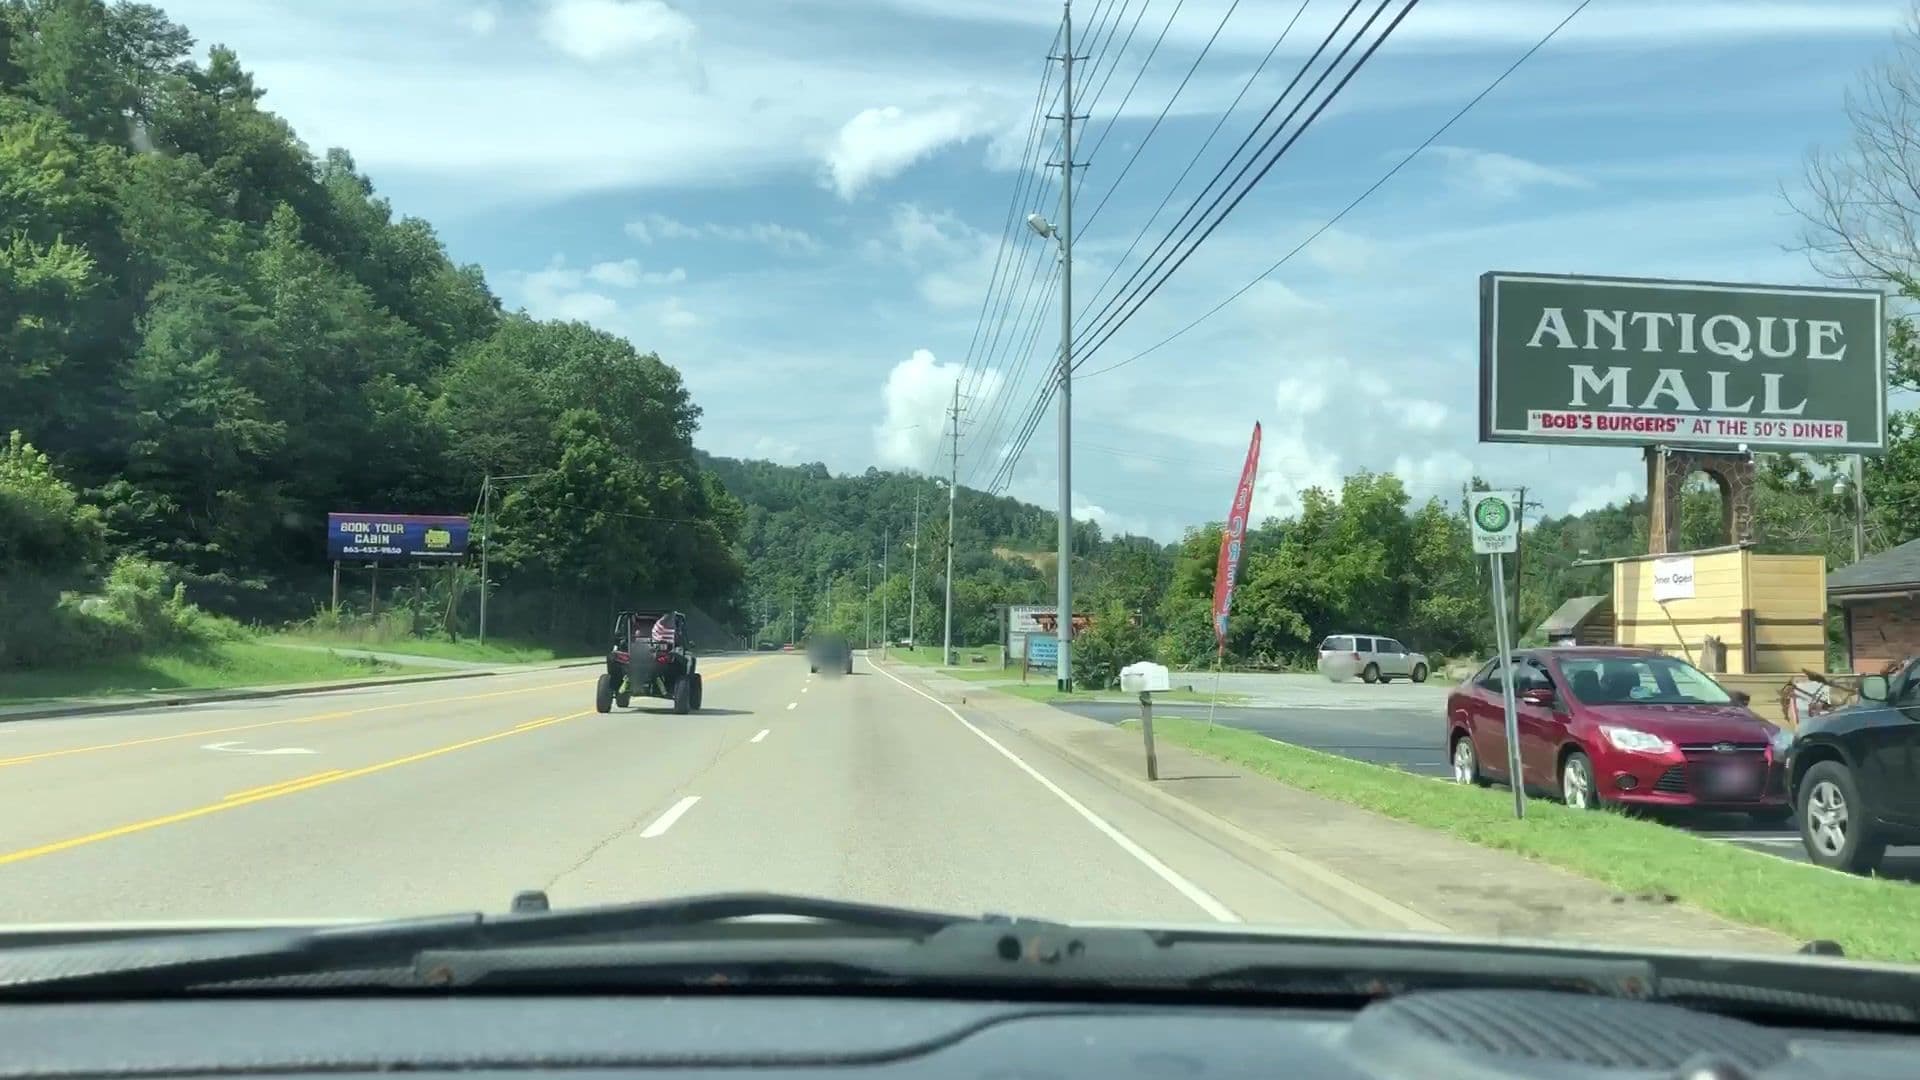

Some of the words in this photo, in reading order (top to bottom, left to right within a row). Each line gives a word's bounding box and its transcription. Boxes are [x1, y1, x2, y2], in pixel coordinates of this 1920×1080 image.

[1526, 307, 1848, 362] ANTIQUE
[1568, 364, 1808, 415] MALL
[1532, 413, 1593, 430] "BOB'S
[1596, 415, 1685, 433] BURGERS"
[1692, 421, 1714, 434] AT
[1718, 420, 1748, 436] THE
[1753, 421, 1787, 438] 50'S
[1793, 422, 1844, 440] DINER
[340, 522, 371, 533] BOOK
[375, 523, 404, 534] YOUR
[354, 534, 390, 544] CABIN
